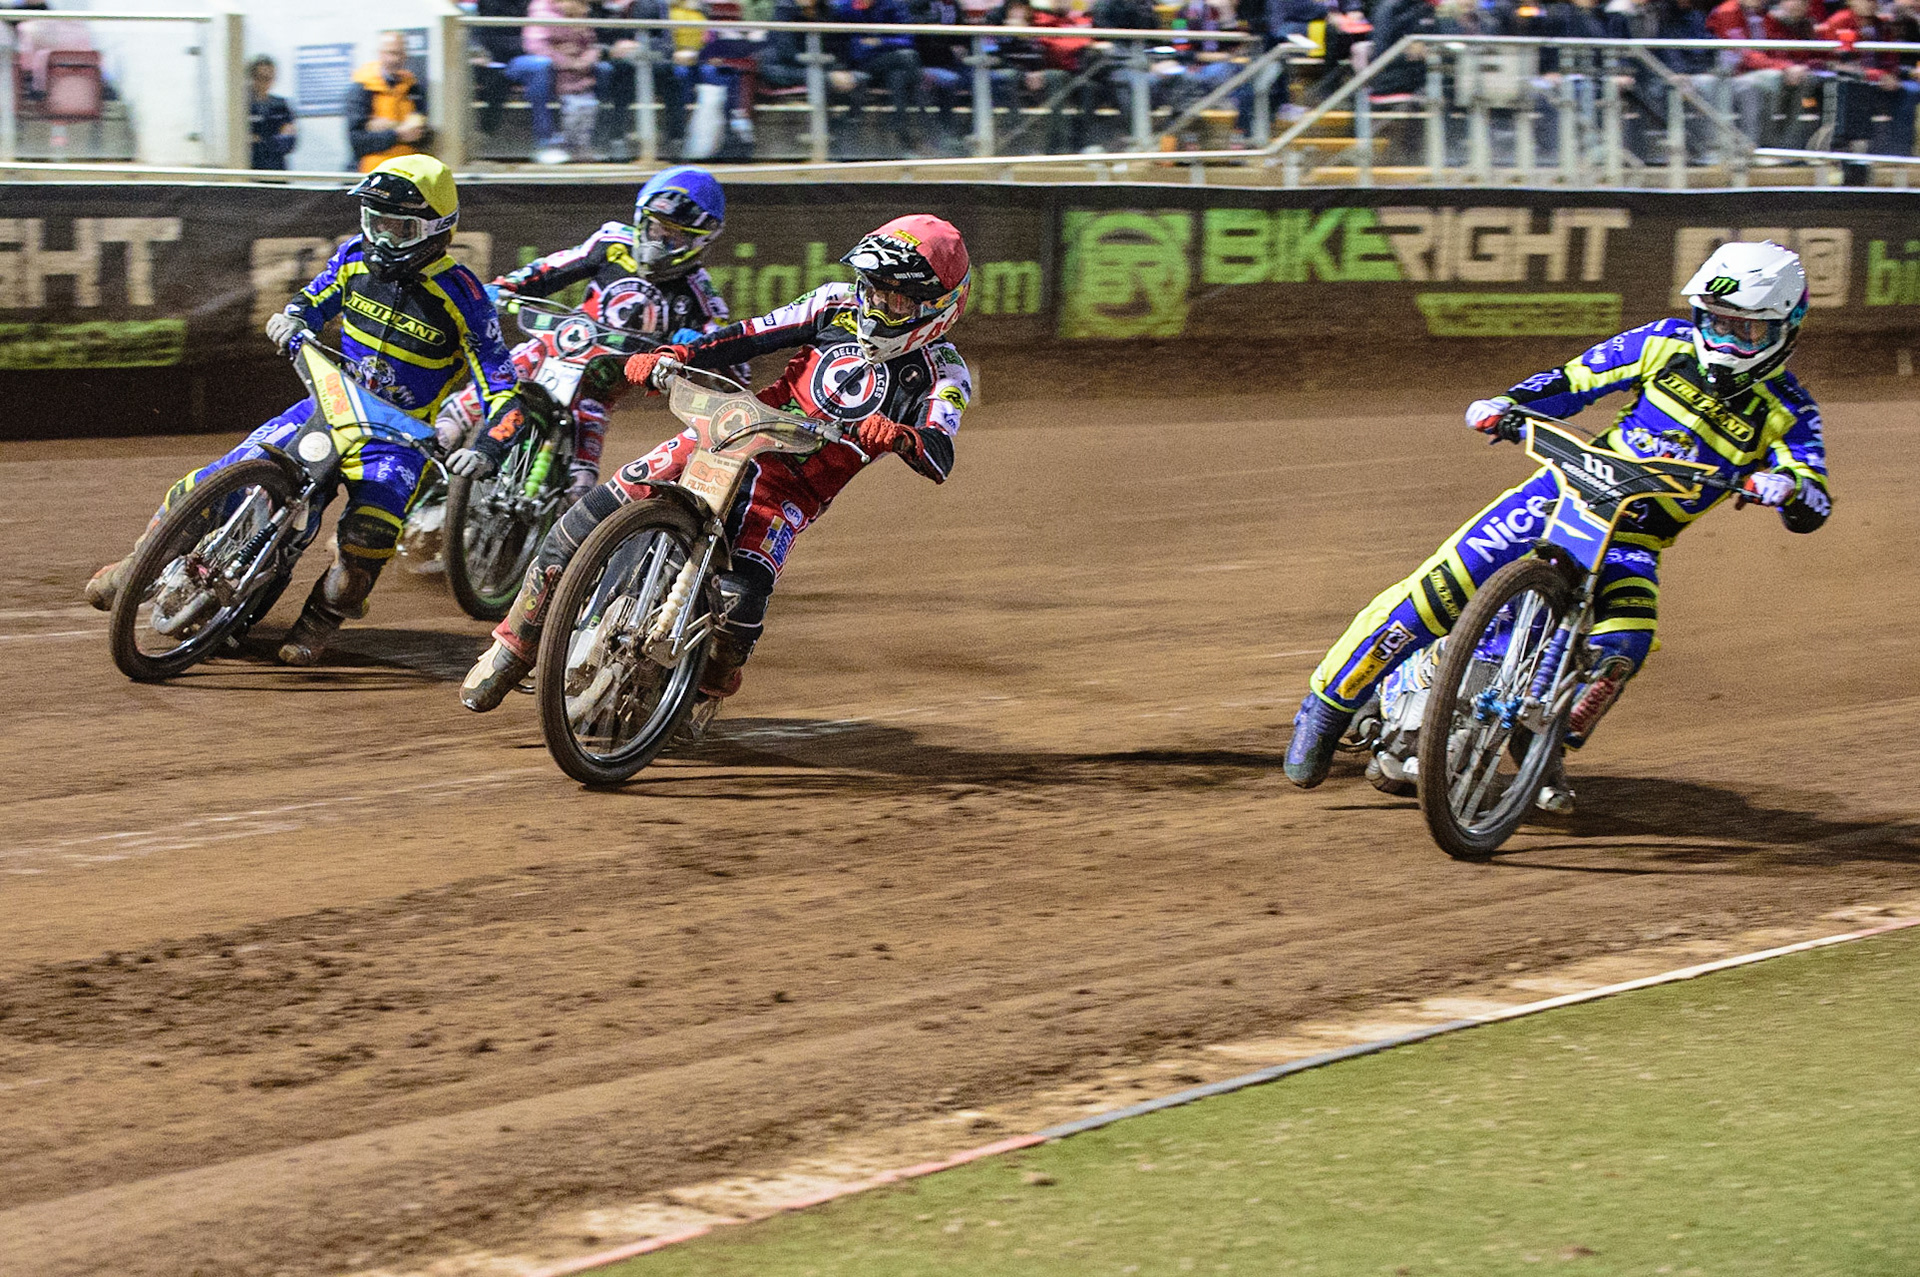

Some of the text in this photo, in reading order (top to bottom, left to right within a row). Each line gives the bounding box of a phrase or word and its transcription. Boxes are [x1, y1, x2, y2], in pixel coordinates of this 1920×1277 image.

[0, 218, 182, 307] HT
[1202, 208, 1631, 283] BIKERIGHT
[832, 346, 863, 359] BELLE
[873, 373, 885, 399] ACES
[1465, 495, 1548, 563] Nice
